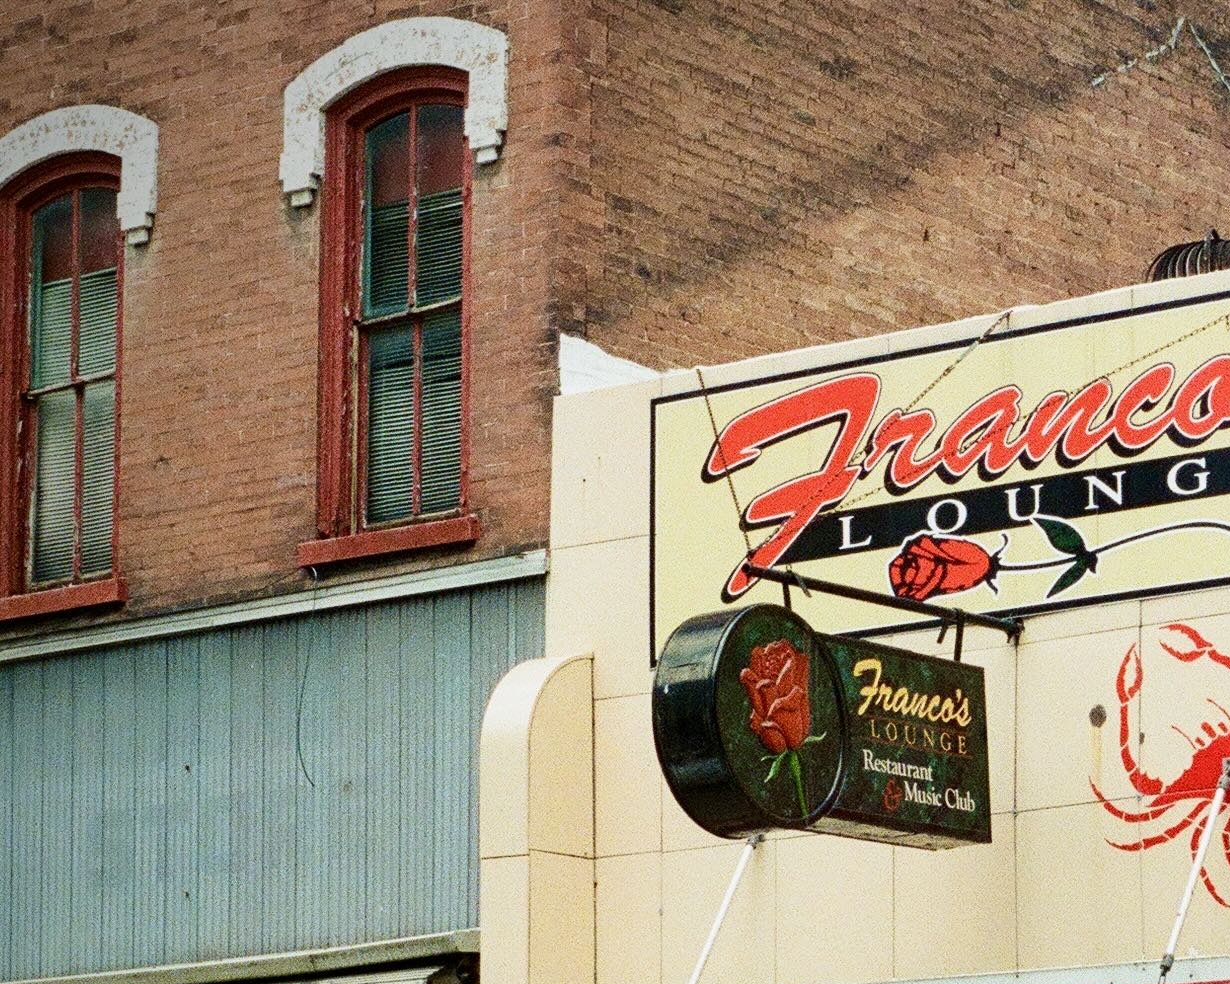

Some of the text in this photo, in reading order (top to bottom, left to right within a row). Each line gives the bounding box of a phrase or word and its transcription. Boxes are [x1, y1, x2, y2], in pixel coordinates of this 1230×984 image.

[853, 658, 973, 728] Franco's
[870, 719, 969, 755] LOUNGE
[862, 749, 934, 782] Restaurant
[882, 778, 976, 812] & Music Club
